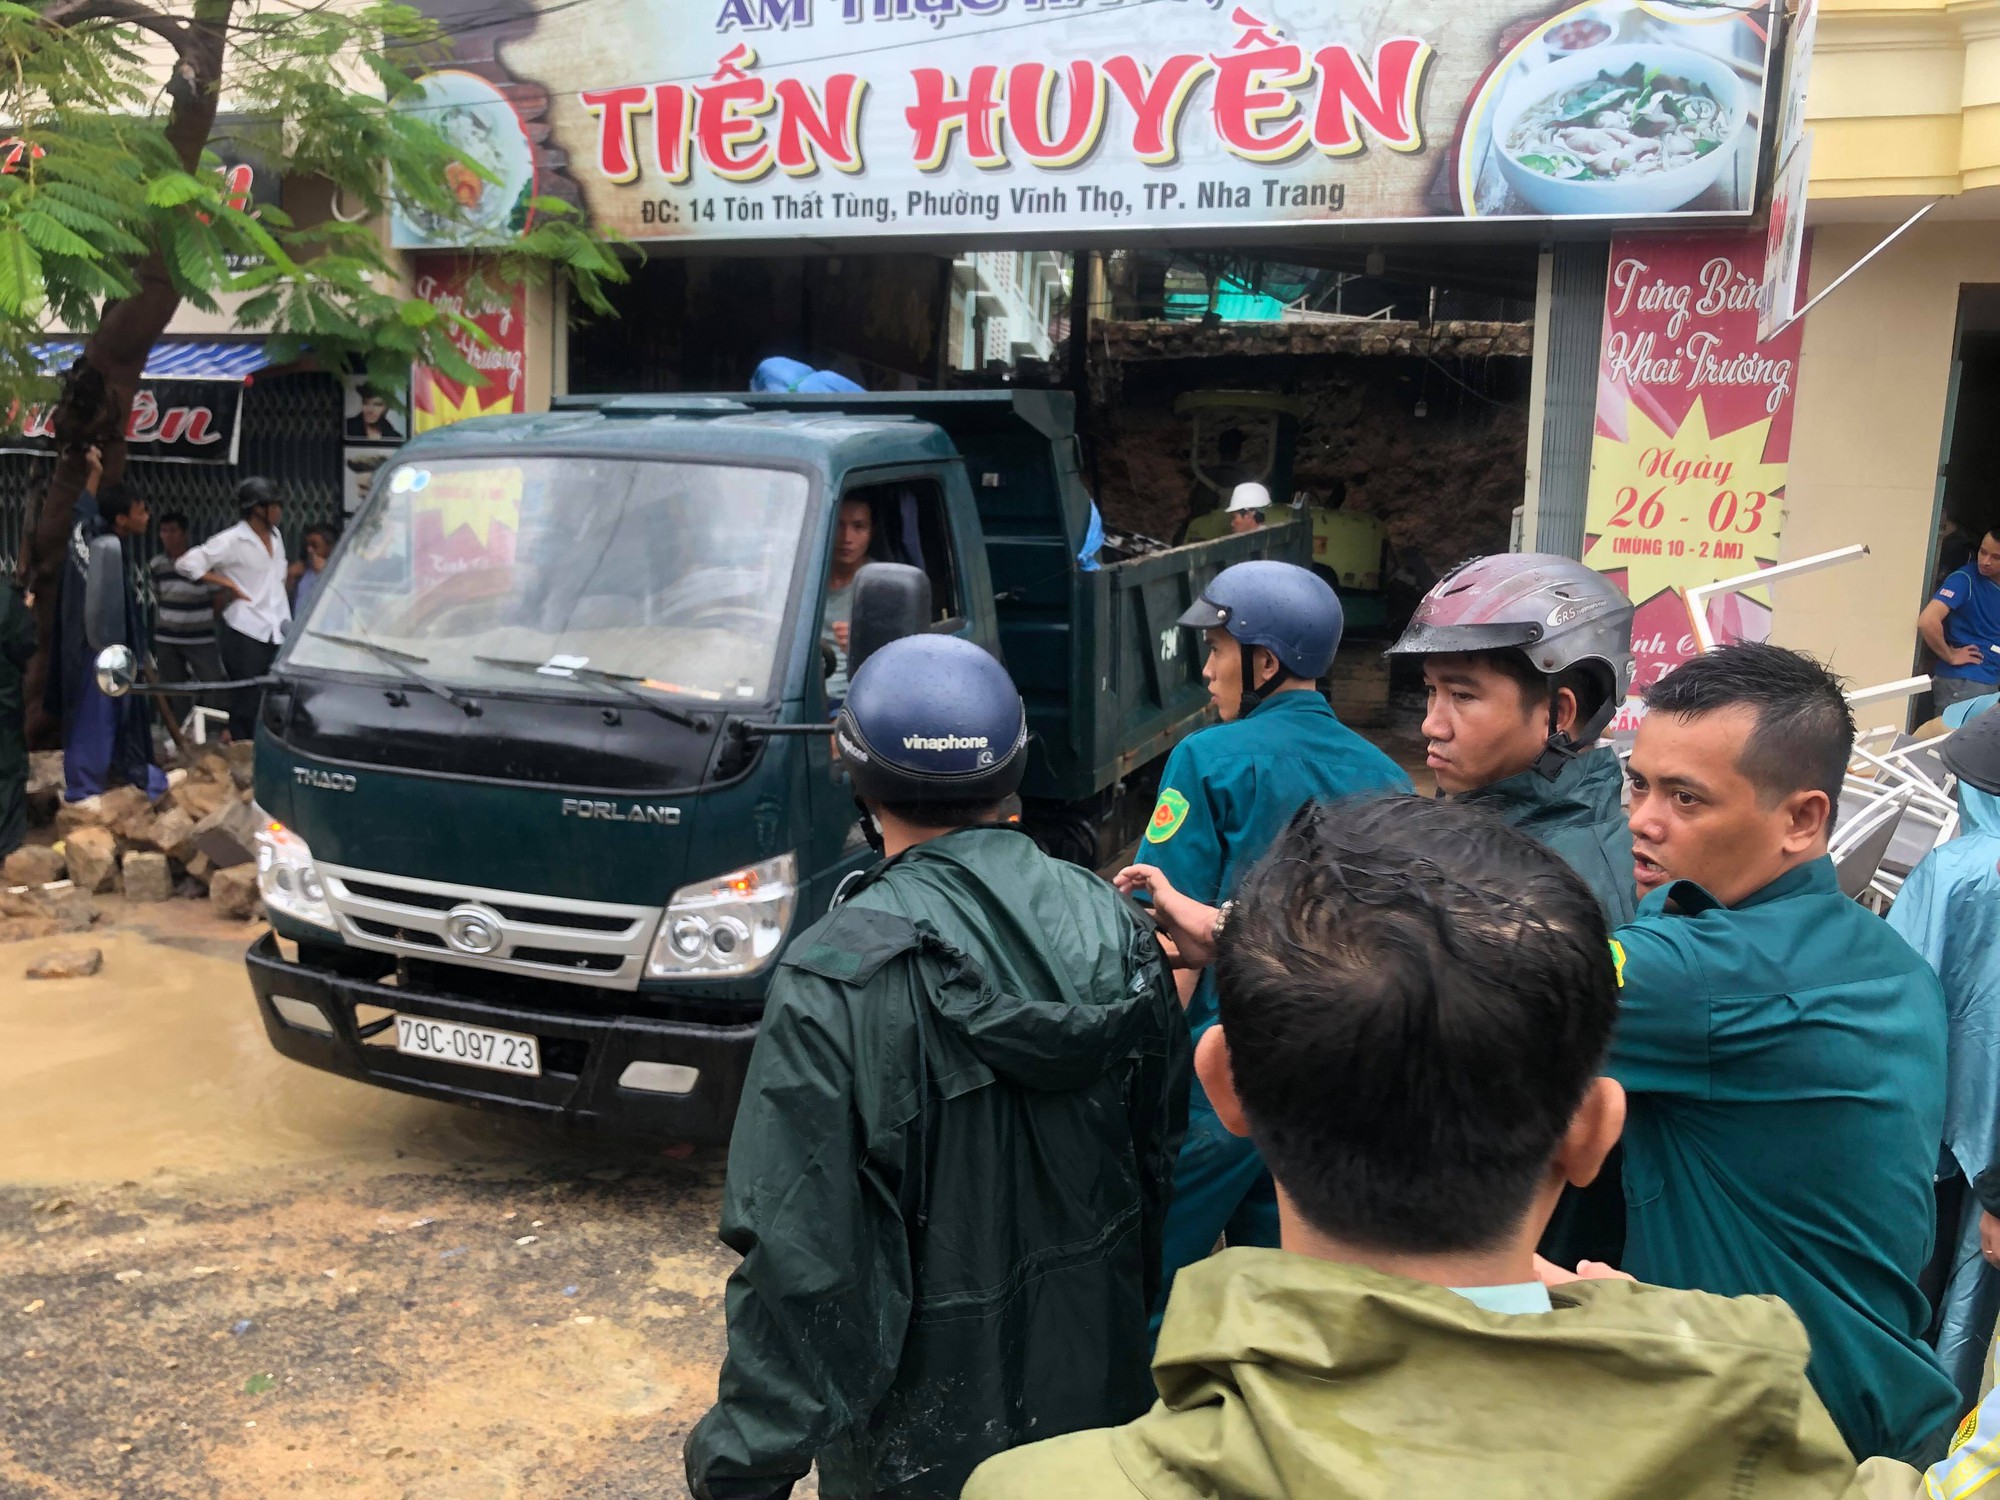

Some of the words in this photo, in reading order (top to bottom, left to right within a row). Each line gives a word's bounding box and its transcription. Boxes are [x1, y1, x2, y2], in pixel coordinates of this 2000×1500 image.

[577, 41, 869, 185] TIẾN
[905, 6, 1433, 172] HUYỀN
[641, 199, 679, 223] ĐC:
[690, 198, 715, 222] 14
[724, 196, 763, 222] Tôn
[773, 190, 824, 219] Thất
[832, 192, 897, 223] Tùng,
[907, 189, 999, 220] Phường
[1010, 185, 1067, 214] Vĩnh
[1077, 185, 1133, 218] Thọ,
[1144, 183, 1186, 212] TP.
[1198, 181, 1251, 209] Nha
[1263, 180, 1345, 211] Trang
[1614, 258, 1691, 338] Tưng
[1695, 257, 1765, 315] Bừn
[1607, 331, 1682, 387] Khai
[1685, 331, 1791, 413] Trương
[1638, 447, 1733, 487] Ngày
[1607, 486, 1667, 530] 26
[1708, 490, 1767, 534] 03
[1667, 541, 1685, 557] 10
[1700, 541, 1709, 558] 2
[903, 733, 988, 752] vinaphone
[292, 766, 357, 793] THACO
[561, 798, 682, 825] FORLAND
[401, 1020, 534, 1069] 79C-097.23
